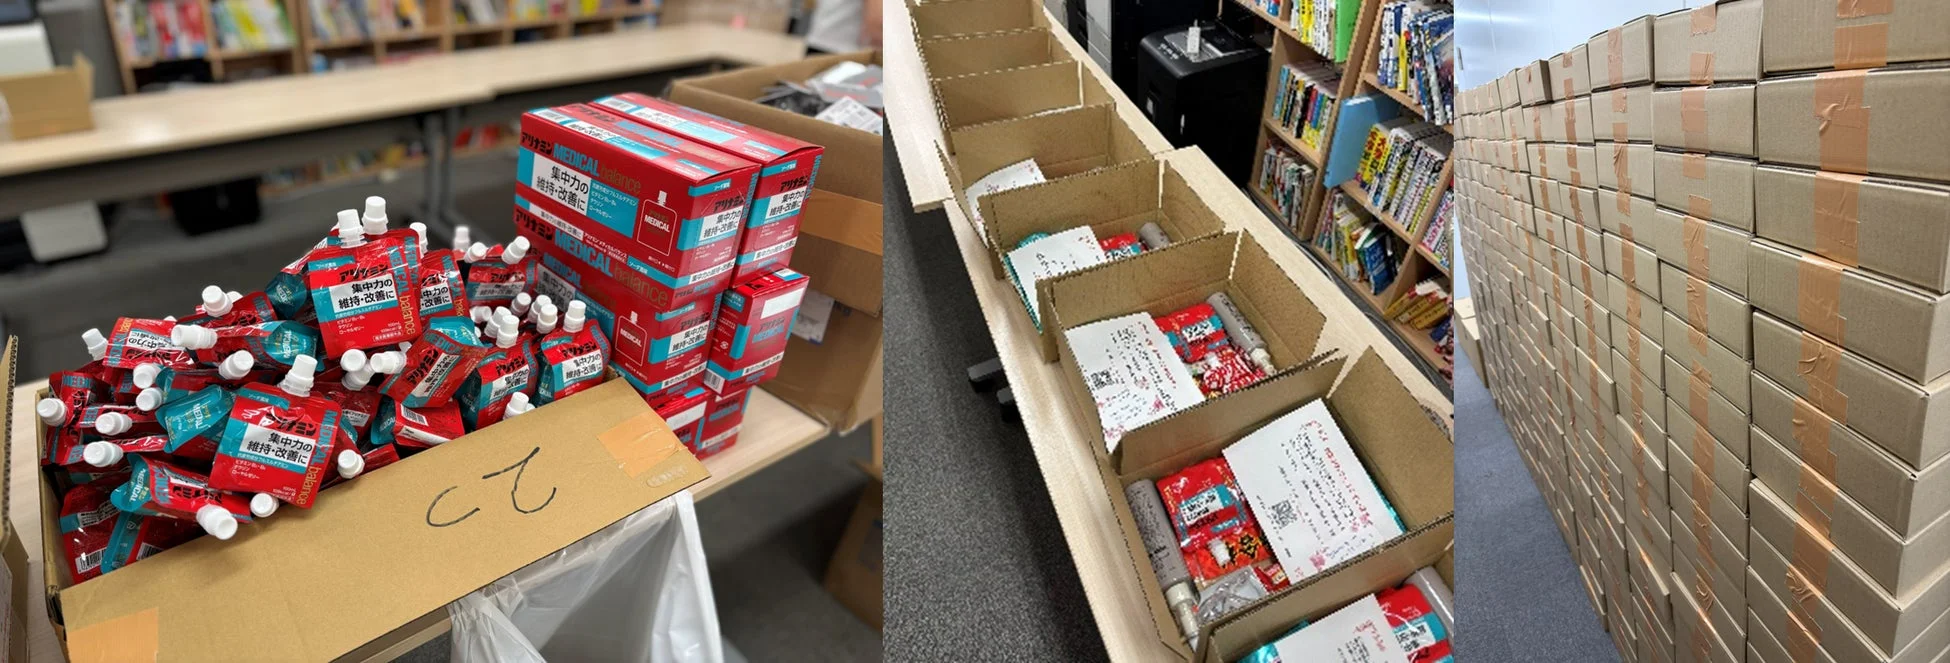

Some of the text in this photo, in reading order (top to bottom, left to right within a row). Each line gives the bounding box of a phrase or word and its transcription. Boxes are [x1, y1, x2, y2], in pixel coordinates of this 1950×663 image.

[521, 132, 553, 155] アリナミン
[554, 143, 600, 176] MEDICAL
[601, 163, 641, 195] balance
[551, 165, 589, 194] 集中力の
[780, 175, 809, 192] アリナミン
[536, 175, 586, 212] 維持・改善に
[714, 194, 745, 212] アリナミン
[782, 191, 806, 204] 集中力の
[715, 209, 742, 225] 集中力の
[769, 201, 801, 217] 維持・改善に
[643, 214, 671, 233] MEDICAL
[703, 220, 739, 239] 維持・改善に
[514, 208, 554, 241] アリナミン
[554, 228, 614, 277] MEDICAL
[614, 263, 669, 307] balance
[543, 252, 584, 289] MEDICAL
[351, 278, 393, 294] 集中力の
[420, 285, 449, 299] 中力の
[338, 290, 395, 310] 維持・改善に
[420, 295, 450, 309] ・改善に
[399, 295, 417, 336] balance
[561, 341, 598, 358] アリナミン
[267, 432, 313, 453] 集中力の
[246, 440, 308, 466] 維持・改善に
[129, 467, 148, 503] MEDICAL
[296, 465, 323, 505] balance
